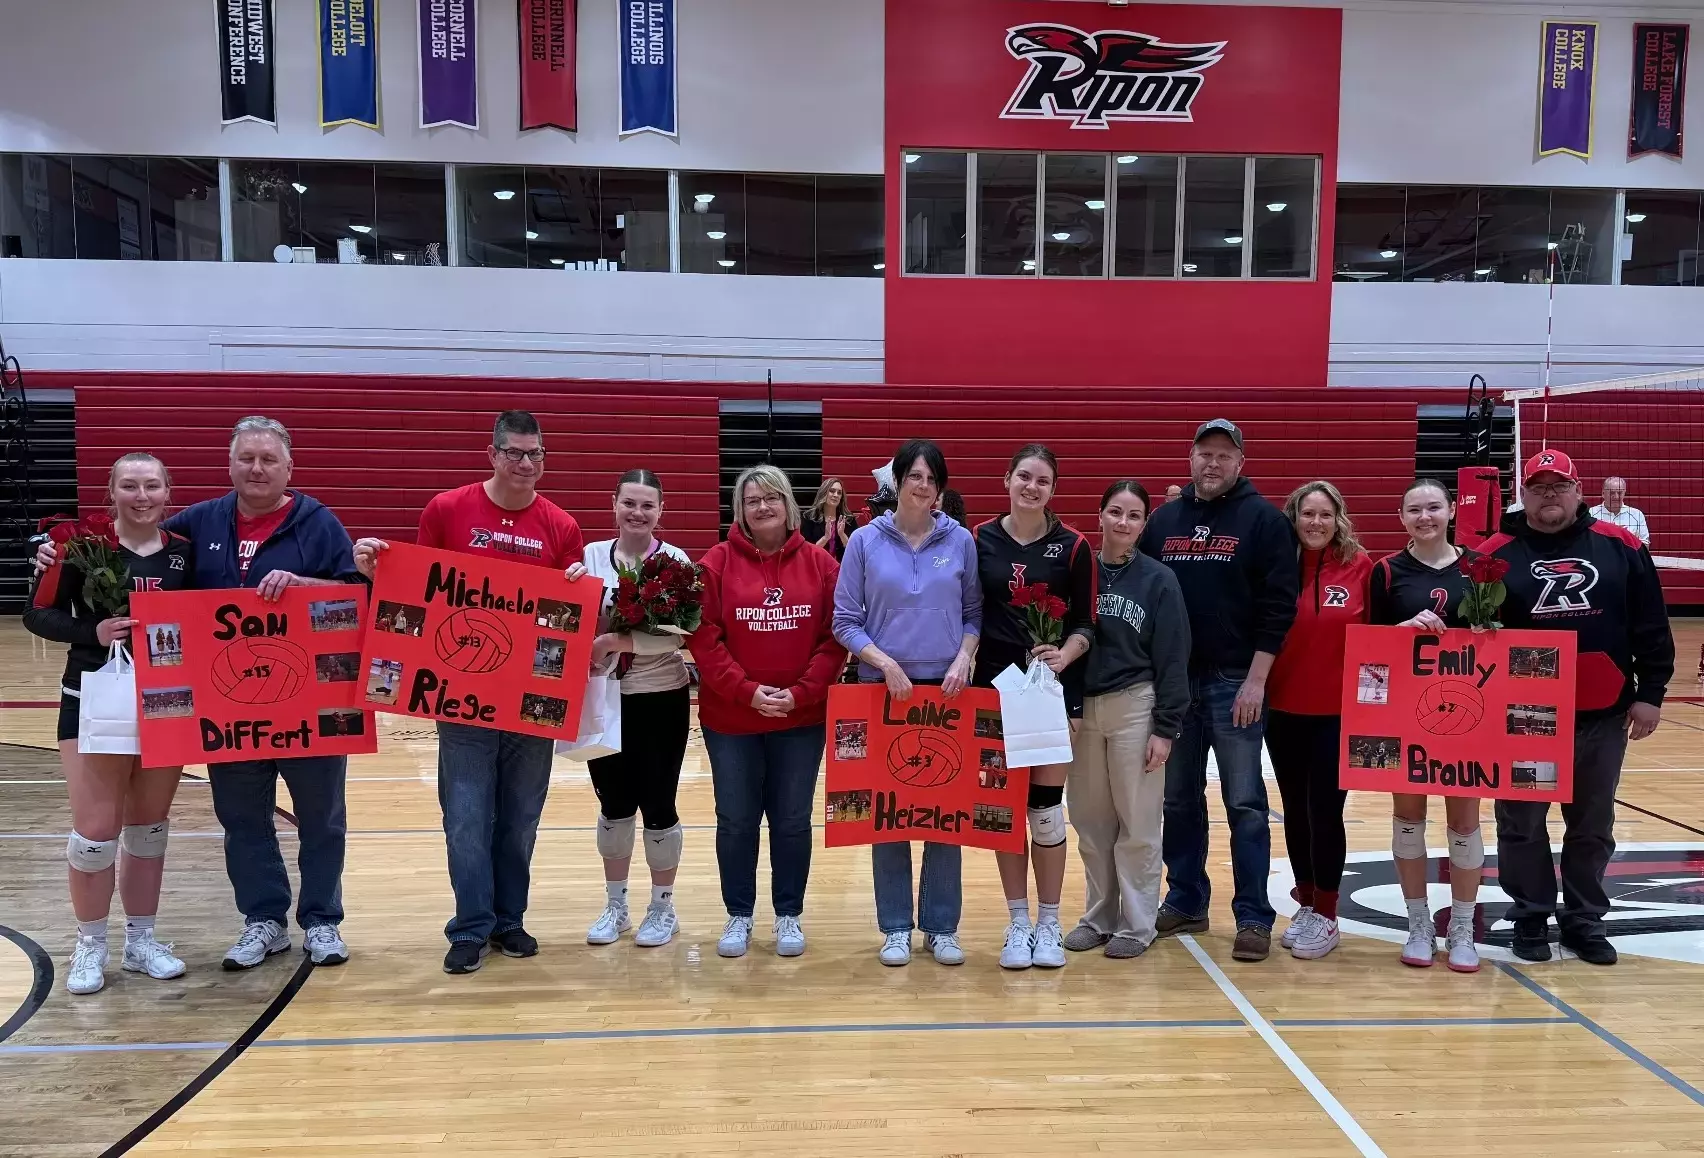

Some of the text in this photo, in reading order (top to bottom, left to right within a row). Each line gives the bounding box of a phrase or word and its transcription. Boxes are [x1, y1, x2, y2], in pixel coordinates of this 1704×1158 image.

[228, 0, 246, 85] ONFERENCE
[330, 0, 347, 57] OLLEGE
[350, 0, 366, 47] ELOIT
[629, 1, 646, 65] COLLEGE
[648, 2, 664, 65] ILLINOIS
[1552, 28, 1569, 90] COLLEGE
[1570, 29, 1586, 71] KNOX
[1642, 31, 1660, 91] COLLEGE
[1656, 31, 1677, 129] LAKE FOREST
[493, 531, 543, 549] RIPON COLLEGE
[1161, 538, 1239, 552] RIPON COLLEGE
[424, 561, 535, 615] Michaela
[1008, 562, 1026, 593] 3
[735, 604, 812, 621] RIPON COLLEGE
[1096, 593, 1146, 634] REEN BAY
[1429, 588, 1447, 617] 2
[457, 635, 481, 648] #13
[747, 619, 799, 632] VOLLEYBALL
[242, 664, 270, 679] #15
[1412, 634, 1497, 689] Emily
[407, 668, 496, 723] Riege
[874, 791, 970, 833] Heizler
